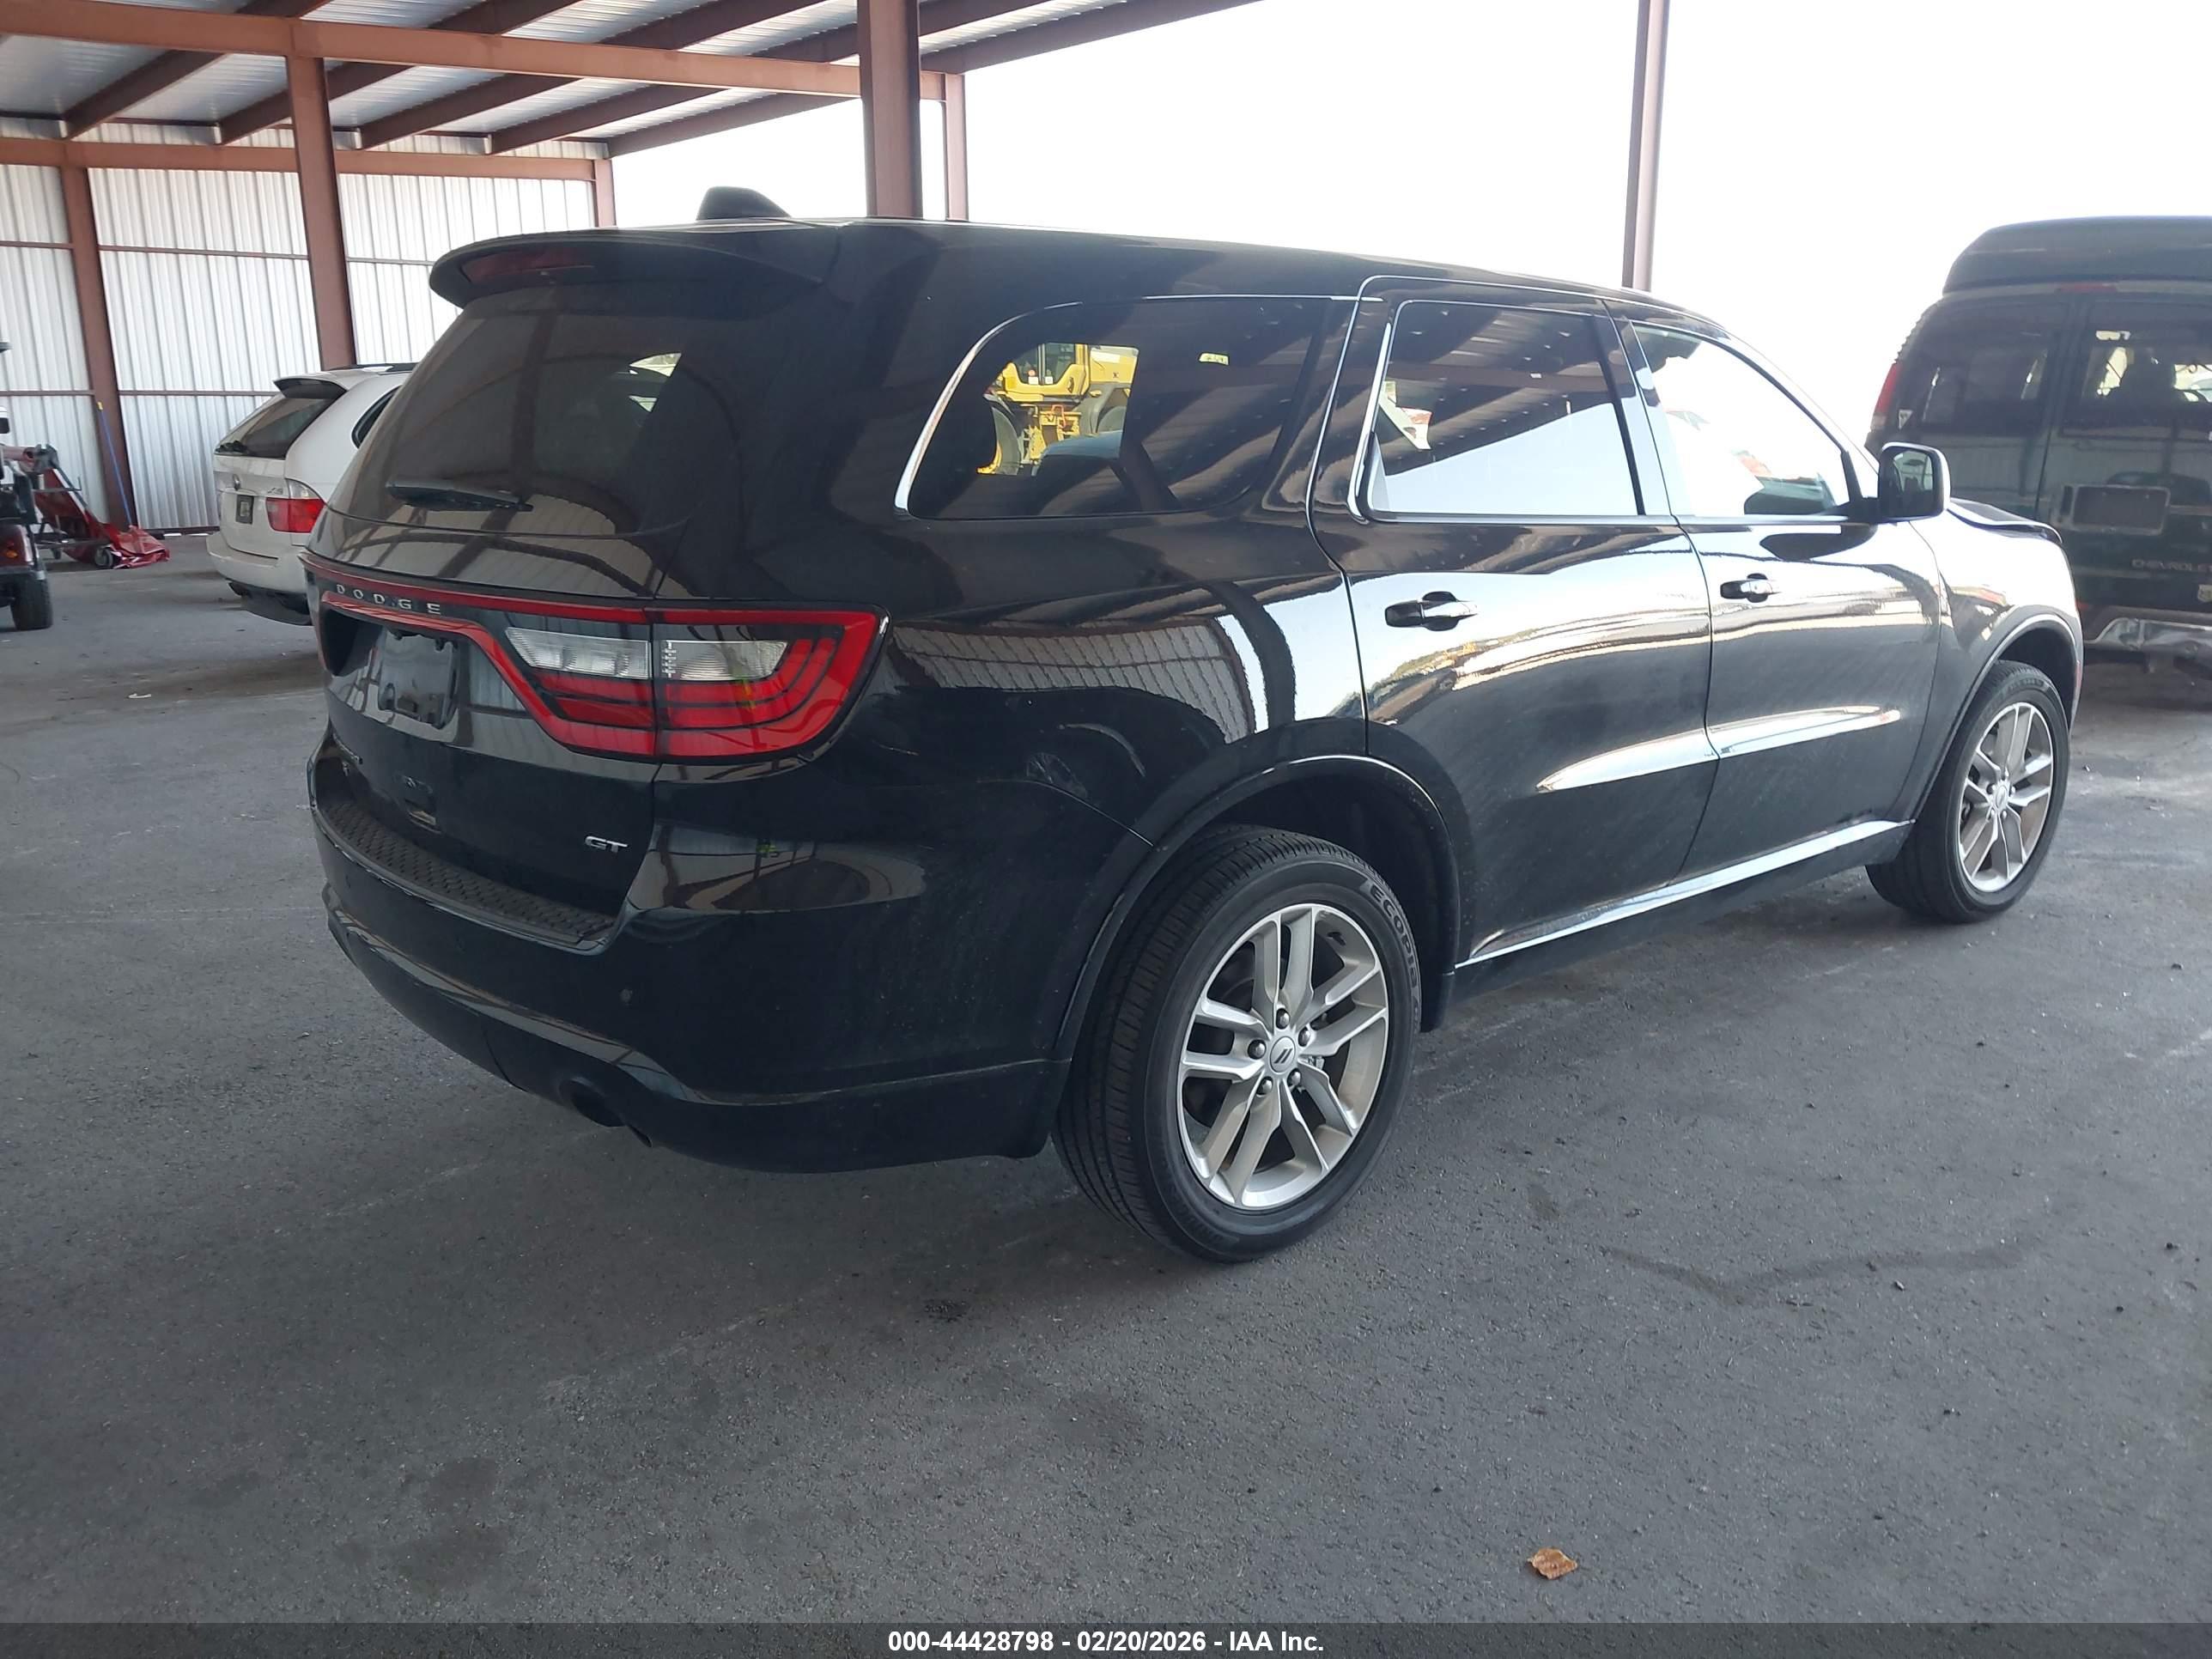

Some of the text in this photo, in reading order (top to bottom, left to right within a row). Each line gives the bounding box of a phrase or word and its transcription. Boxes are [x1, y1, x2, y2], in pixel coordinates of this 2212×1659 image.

[336, 584, 441, 615] DODGE
[585, 836, 629, 853] GT
[1370, 884, 1418, 988] ECOPIA
